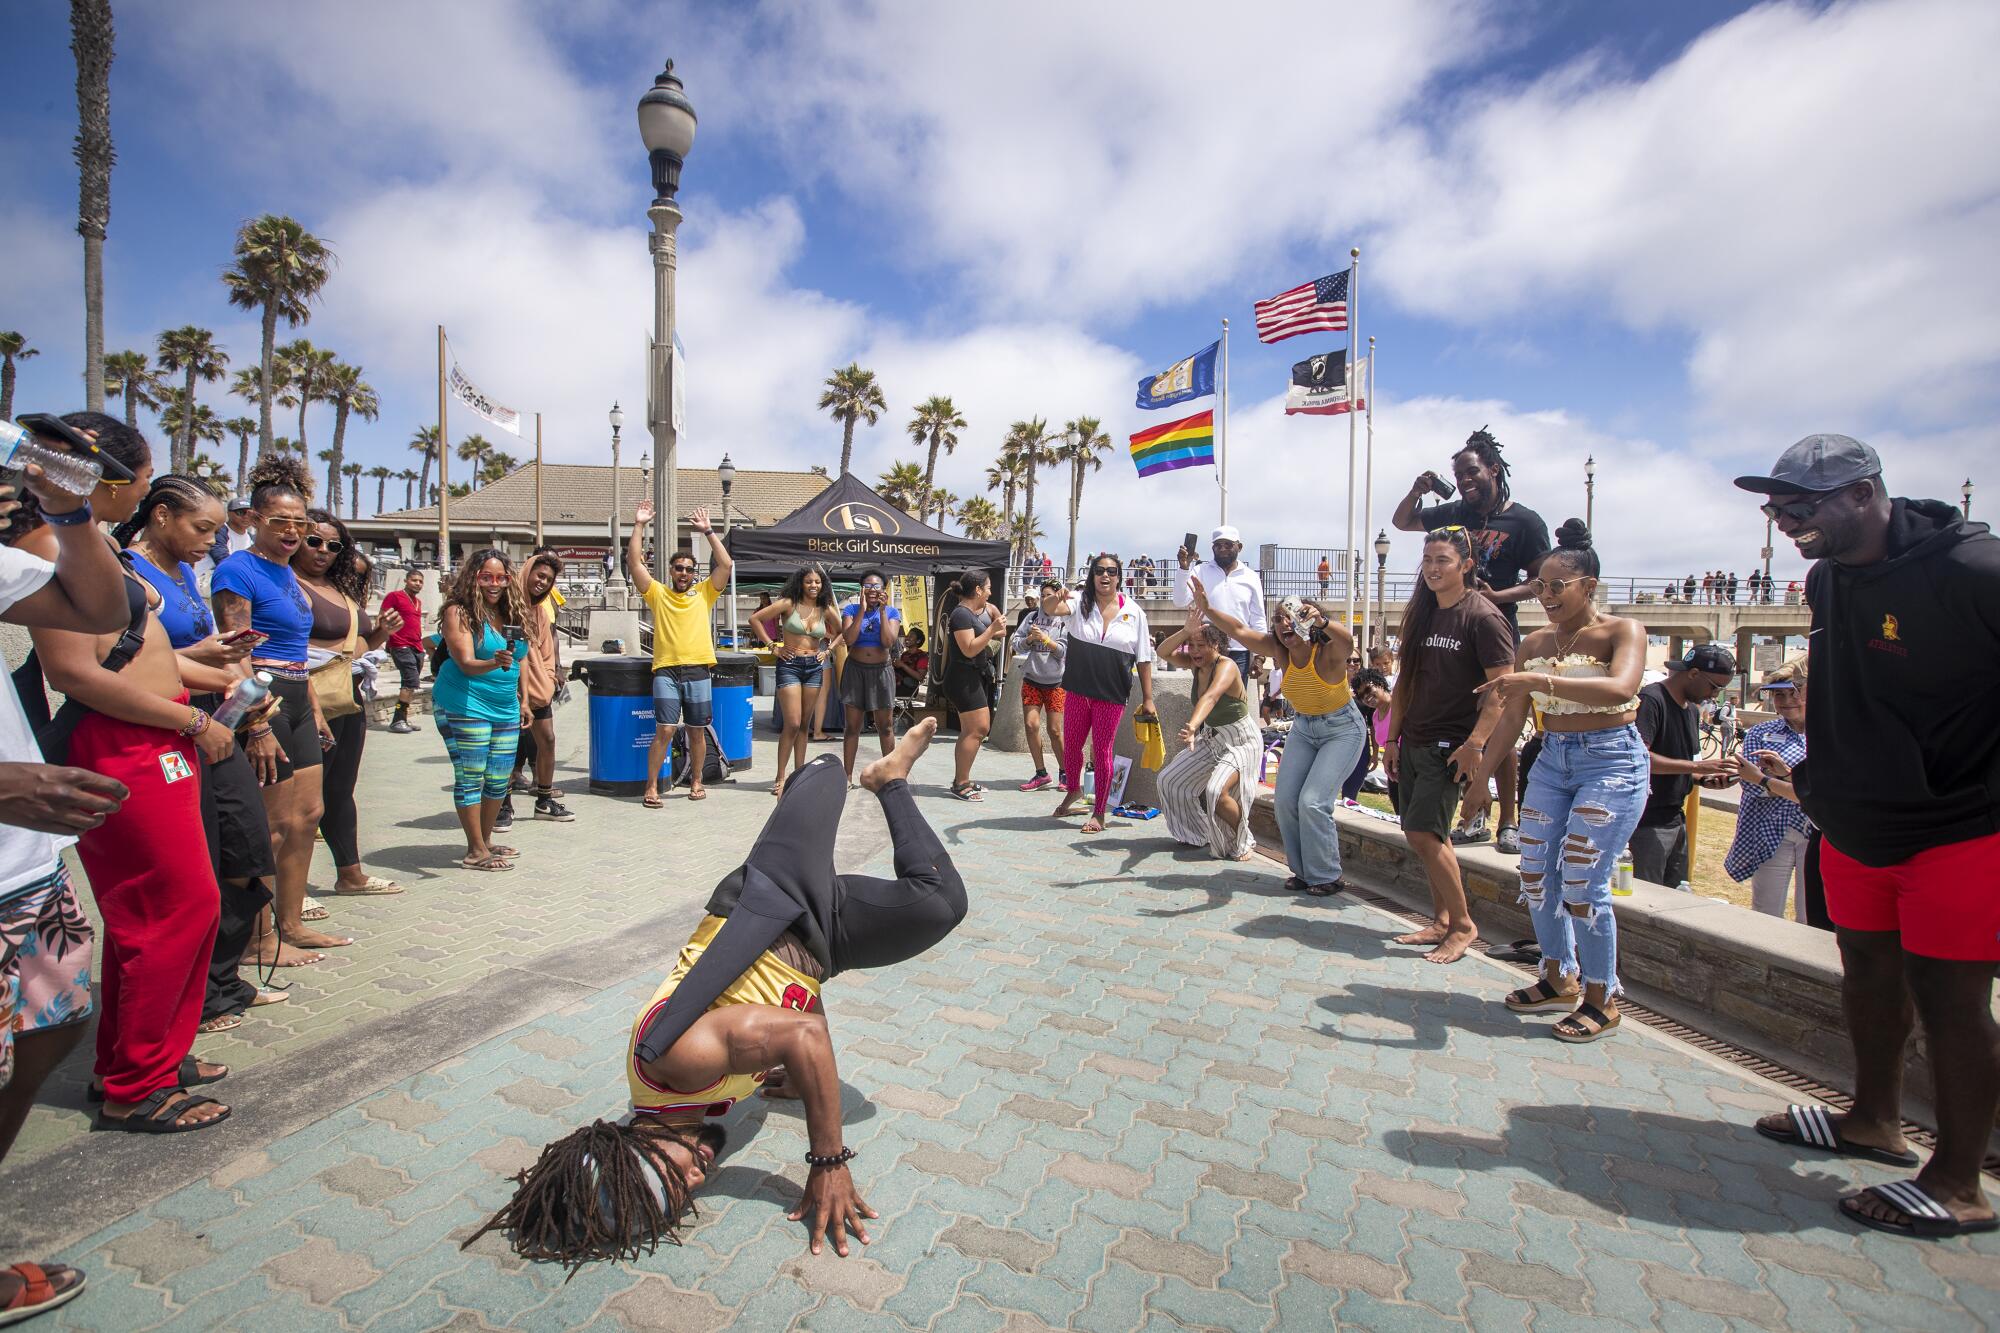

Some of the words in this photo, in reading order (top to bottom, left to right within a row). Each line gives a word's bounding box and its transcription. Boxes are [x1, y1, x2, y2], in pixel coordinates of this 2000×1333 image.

[462, 385, 477, 402] Car
[808, 538, 844, 552] Black
[846, 539, 870, 554] Girl
[872, 540, 940, 556] Sunscreen
[1422, 633, 1462, 652] olonize
